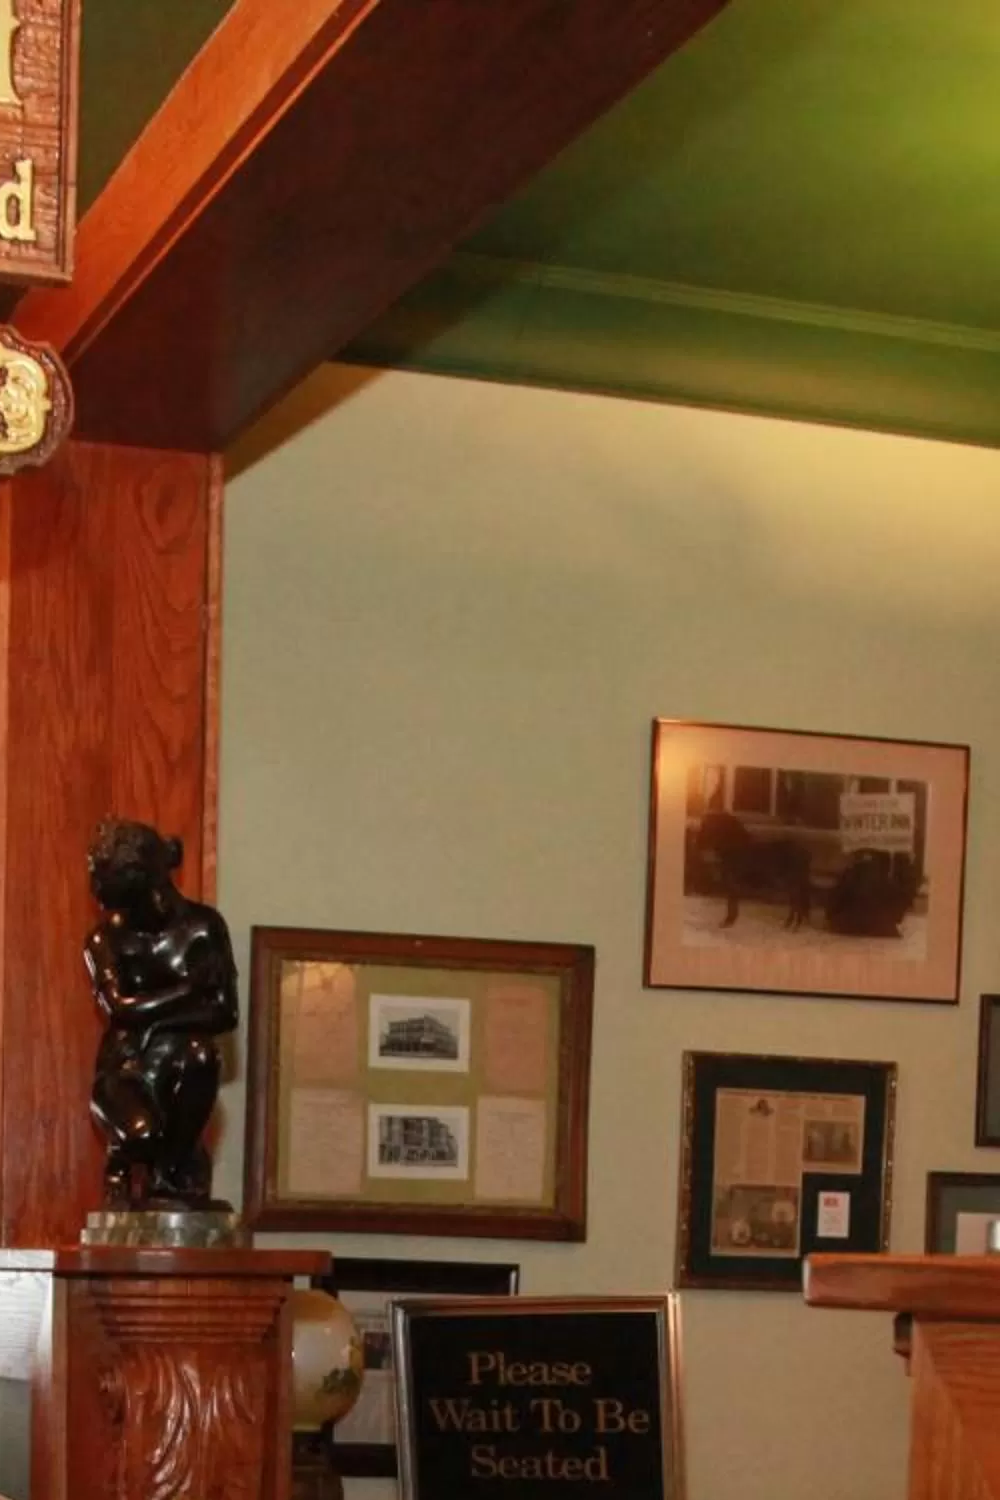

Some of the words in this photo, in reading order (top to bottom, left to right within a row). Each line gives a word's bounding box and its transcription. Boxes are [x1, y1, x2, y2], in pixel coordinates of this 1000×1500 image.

[466, 1351, 593, 1388] Please
[428, 1396, 521, 1433] Wait
[530, 1397, 583, 1434] To
[594, 1398, 650, 1434] Be
[470, 1444, 610, 1482] Seated
